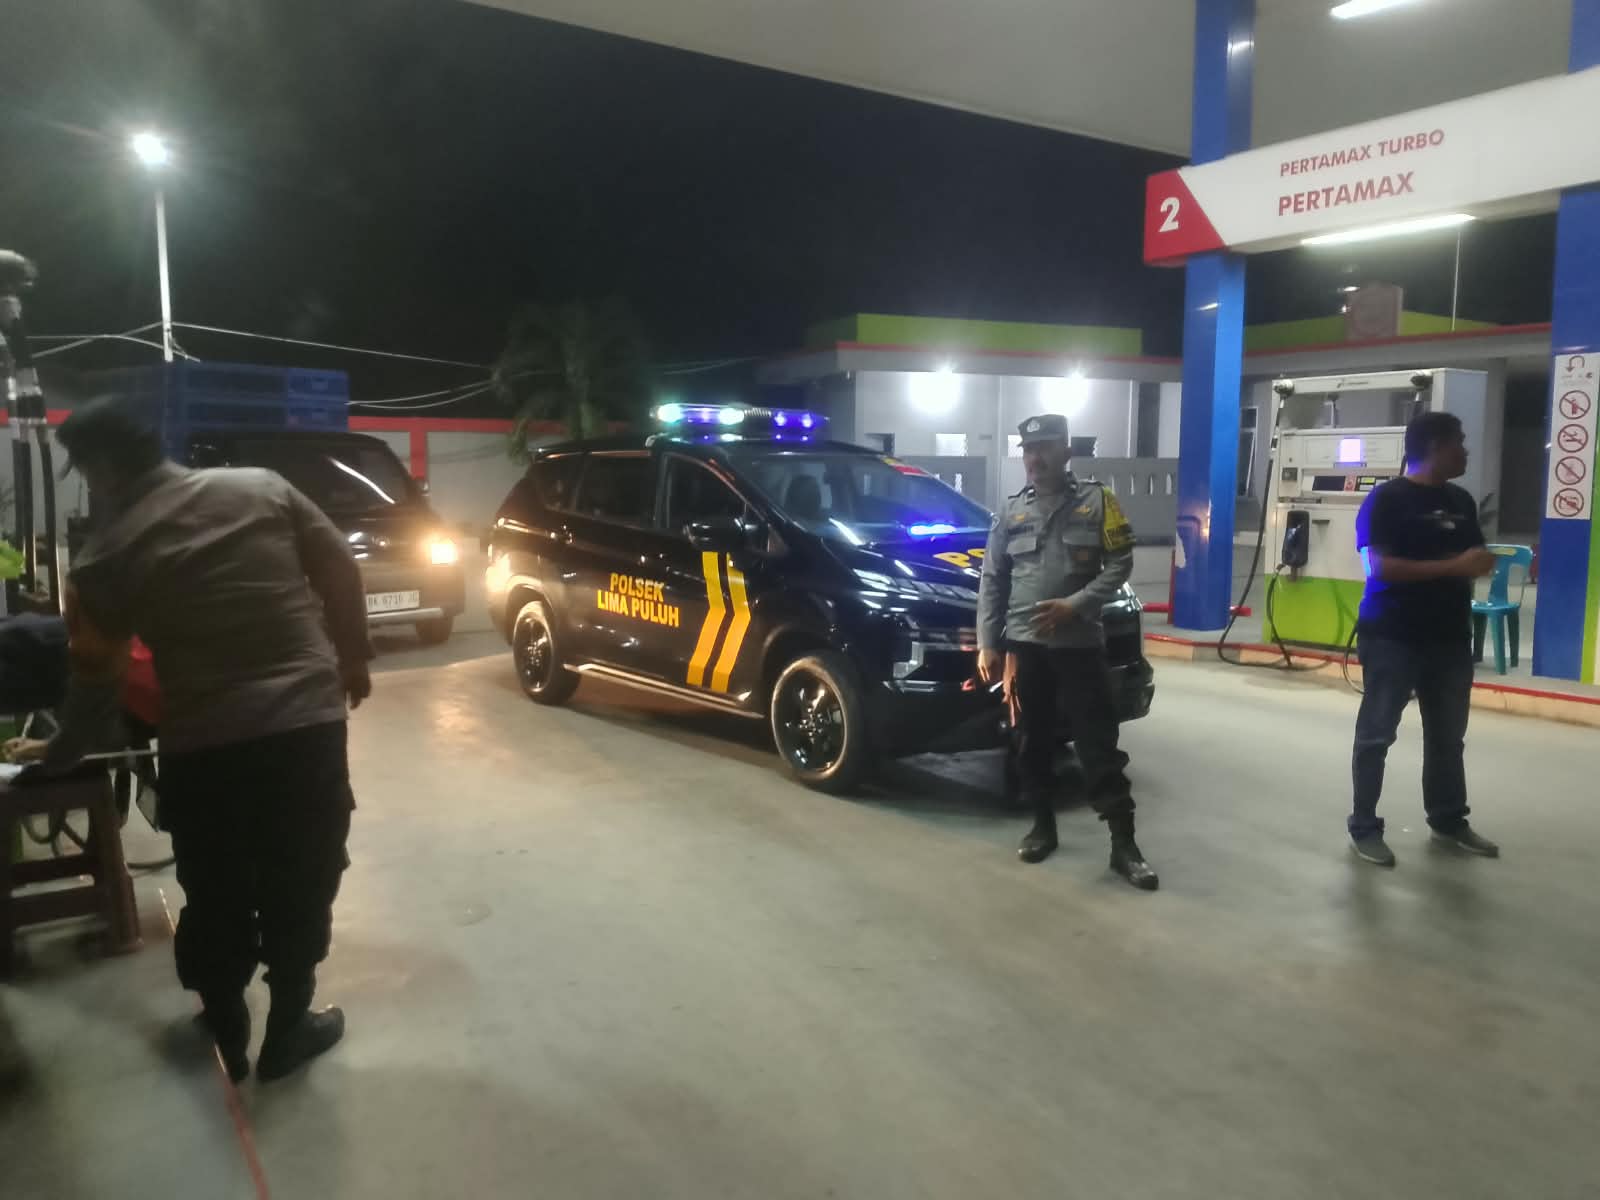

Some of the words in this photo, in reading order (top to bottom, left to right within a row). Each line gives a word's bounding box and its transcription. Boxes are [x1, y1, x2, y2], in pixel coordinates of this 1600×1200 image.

[1280, 144, 1372, 177] PERTAMAX
[1378, 129, 1446, 157] TURBO
[1278, 172, 1414, 216] PERTAMAX
[1159, 197, 1180, 232] 2
[610, 573, 664, 602] POLSEK
[597, 590, 629, 616] LIMA
[630, 597, 680, 627] PULUH
